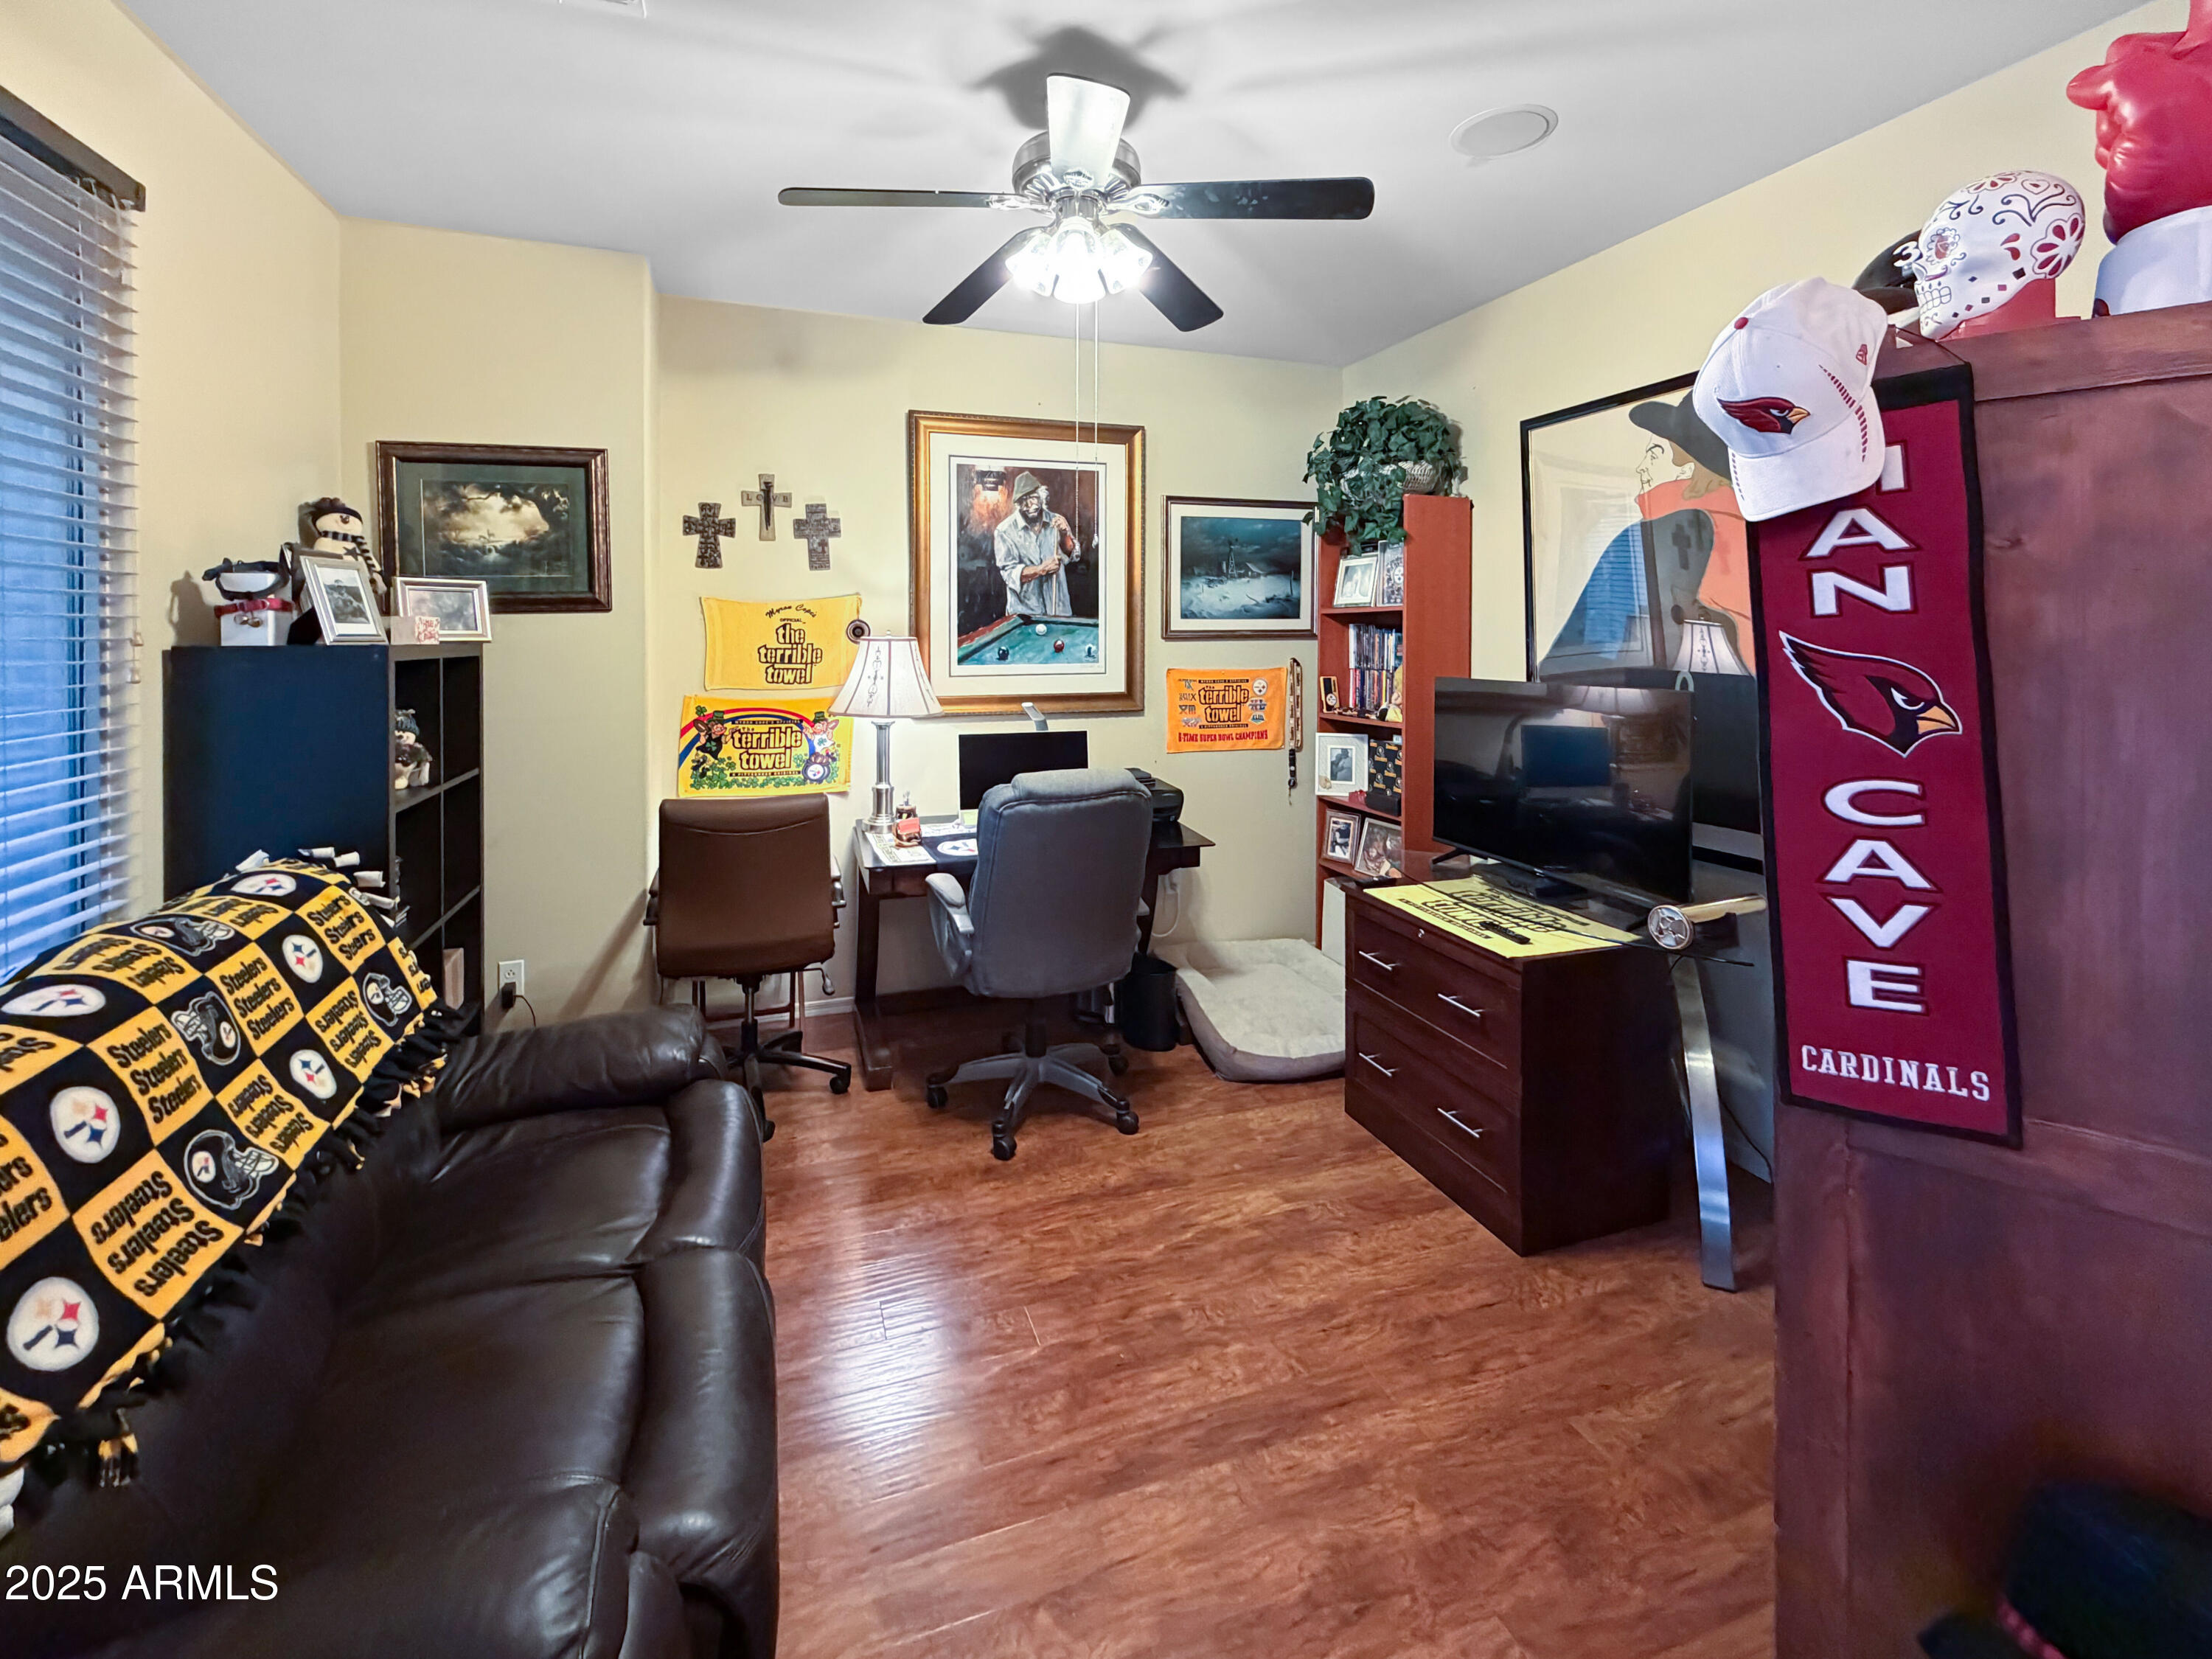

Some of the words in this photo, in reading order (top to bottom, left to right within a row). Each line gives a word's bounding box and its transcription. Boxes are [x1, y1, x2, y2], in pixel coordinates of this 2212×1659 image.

[1799, 439, 1921, 618] AN
[757, 643, 823, 664] terrible
[776, 623, 805, 644] the
[765, 664, 813, 684] towel
[1198, 685, 1249, 705] terrible
[1205, 703, 1241, 723] towel
[731, 726, 803, 749] terrible
[1200, 733, 1217, 742] SUPER
[1218, 733, 1234, 741] BOWL
[1235, 729, 1267, 740] CHAMPIONS
[740, 748, 792, 770] towel
[1817, 776, 1942, 1015] CAVE
[220, 957, 267, 995] Steelers
[234, 977, 282, 1018] Steelers
[246, 997, 295, 1040] Steelers
[107, 1022, 172, 1068] Steelers
[131, 1048, 188, 1096] Steelers
[1801, 1045, 1990, 1102] CARDINALS
[148, 1074, 203, 1124] Steelers
[91, 1171, 173, 1245] Steelers
[107, 1197, 195, 1275] Steelers
[134, 1220, 224, 1298] Steelers
